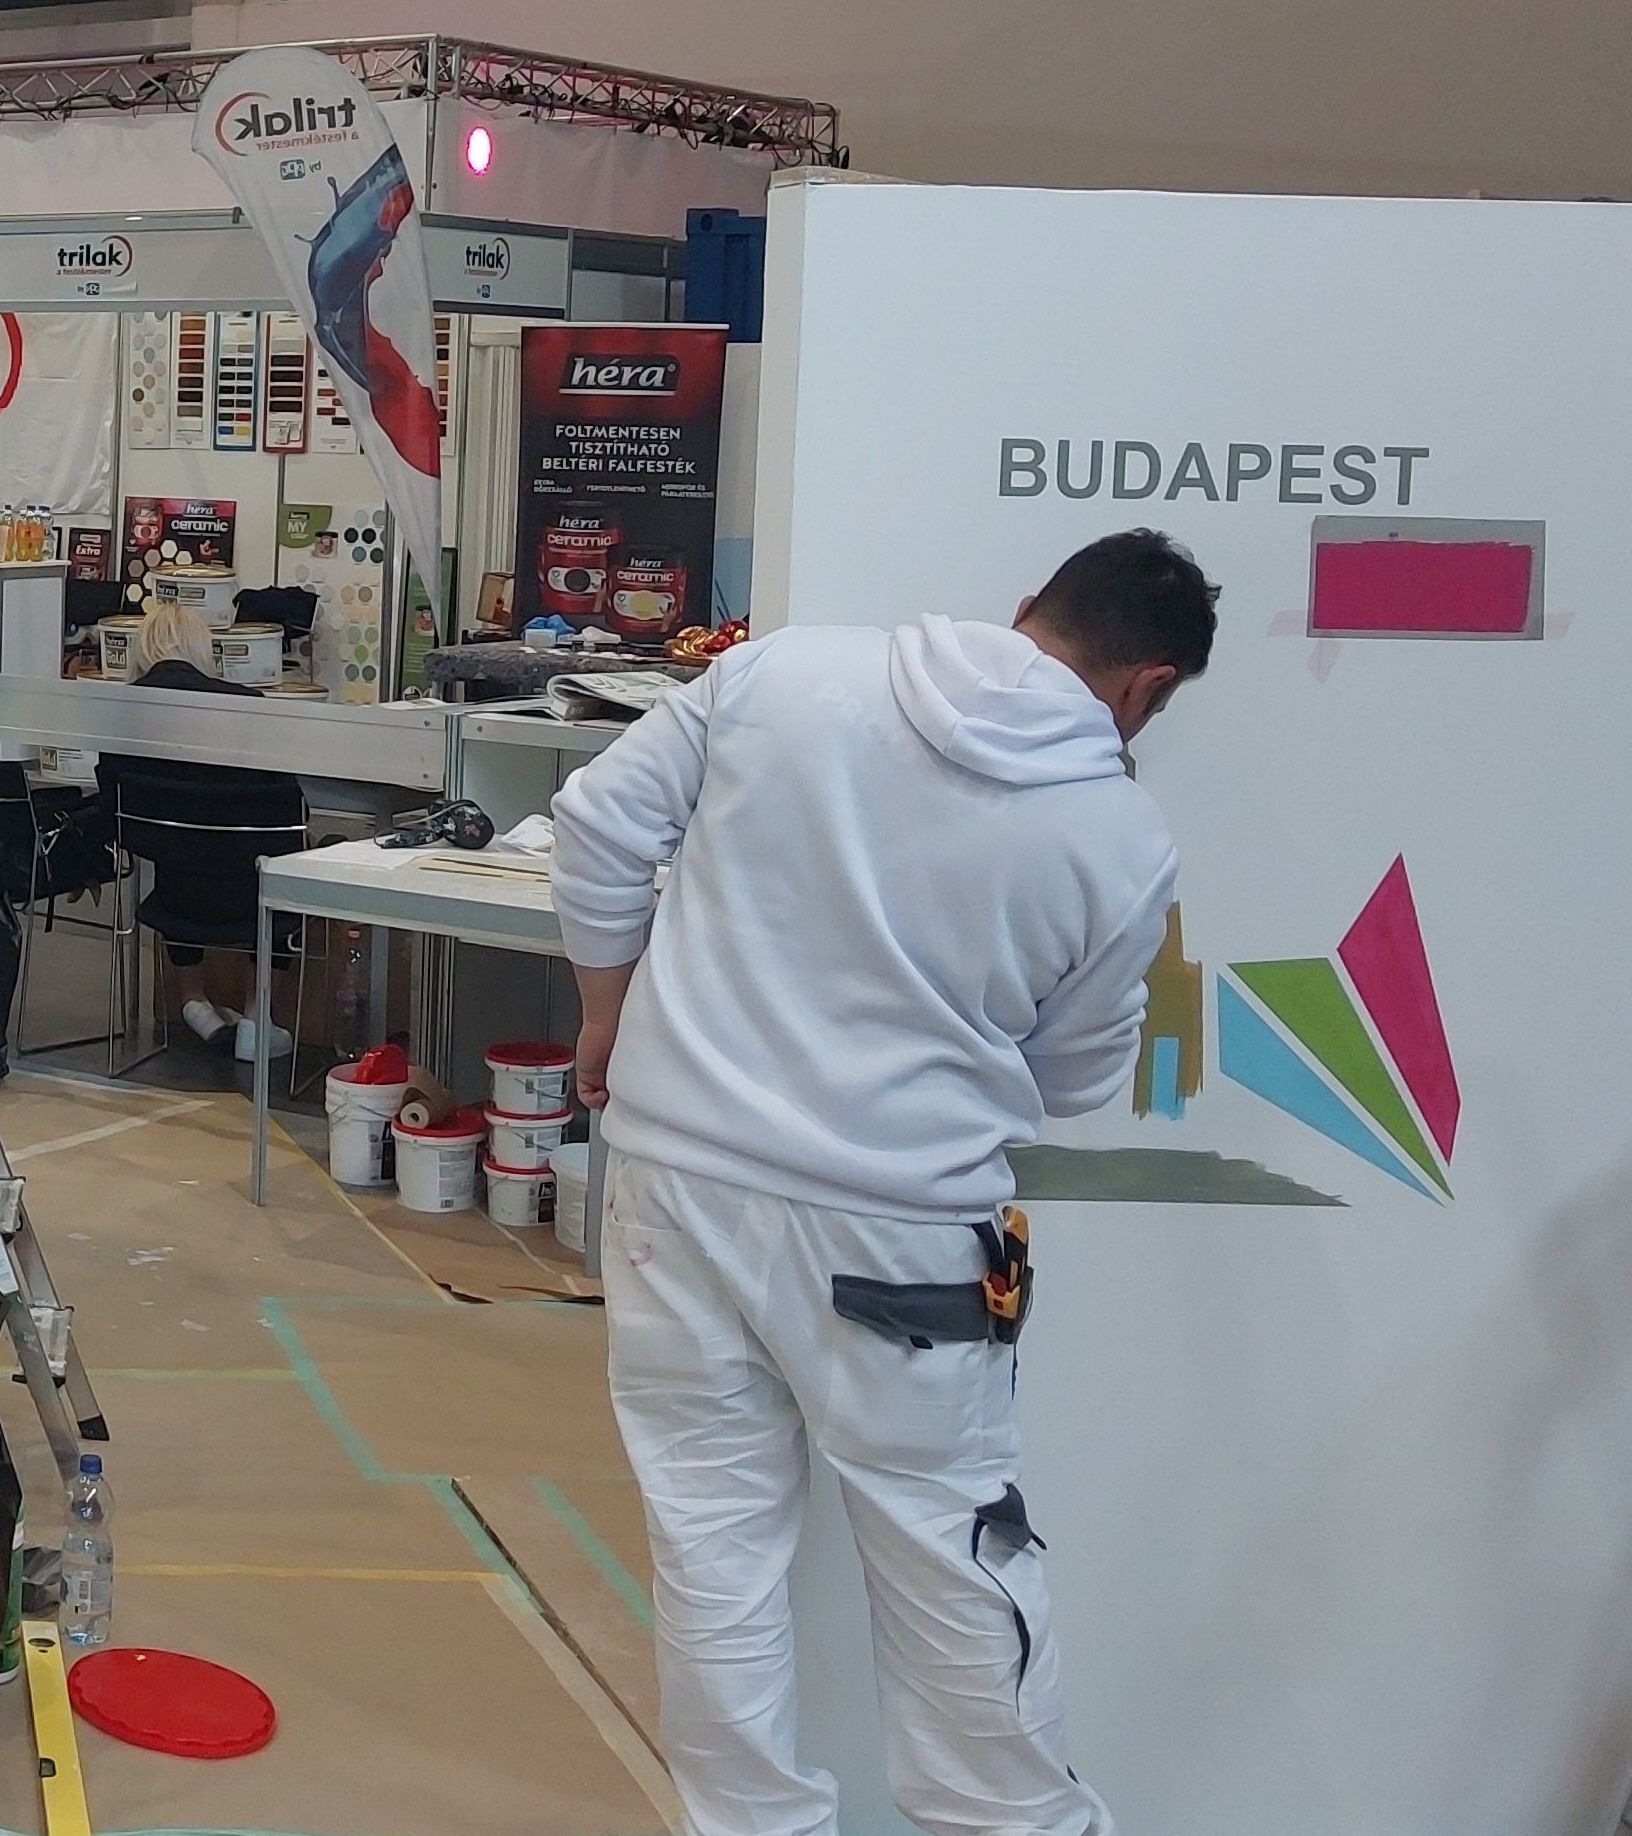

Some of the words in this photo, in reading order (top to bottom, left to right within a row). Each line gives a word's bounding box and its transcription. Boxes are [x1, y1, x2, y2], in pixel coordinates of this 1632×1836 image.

[57, 242, 123, 267] trilak
[465, 243, 505, 269] trilak
[555, 424, 681, 440] FOLTMENTESEN
[568, 439, 670, 456] TISZTÍTHATÓ
[542, 455, 604, 471] BELTÉRI
[608, 457, 697, 474] FALFESTÉK
[998, 437, 1431, 506] BUDAPEST
[171, 519, 229, 533] ceramic
[546, 533, 613, 547] ceramic
[75, 544, 102, 556] Extra
[617, 570, 675, 582] ceramic
